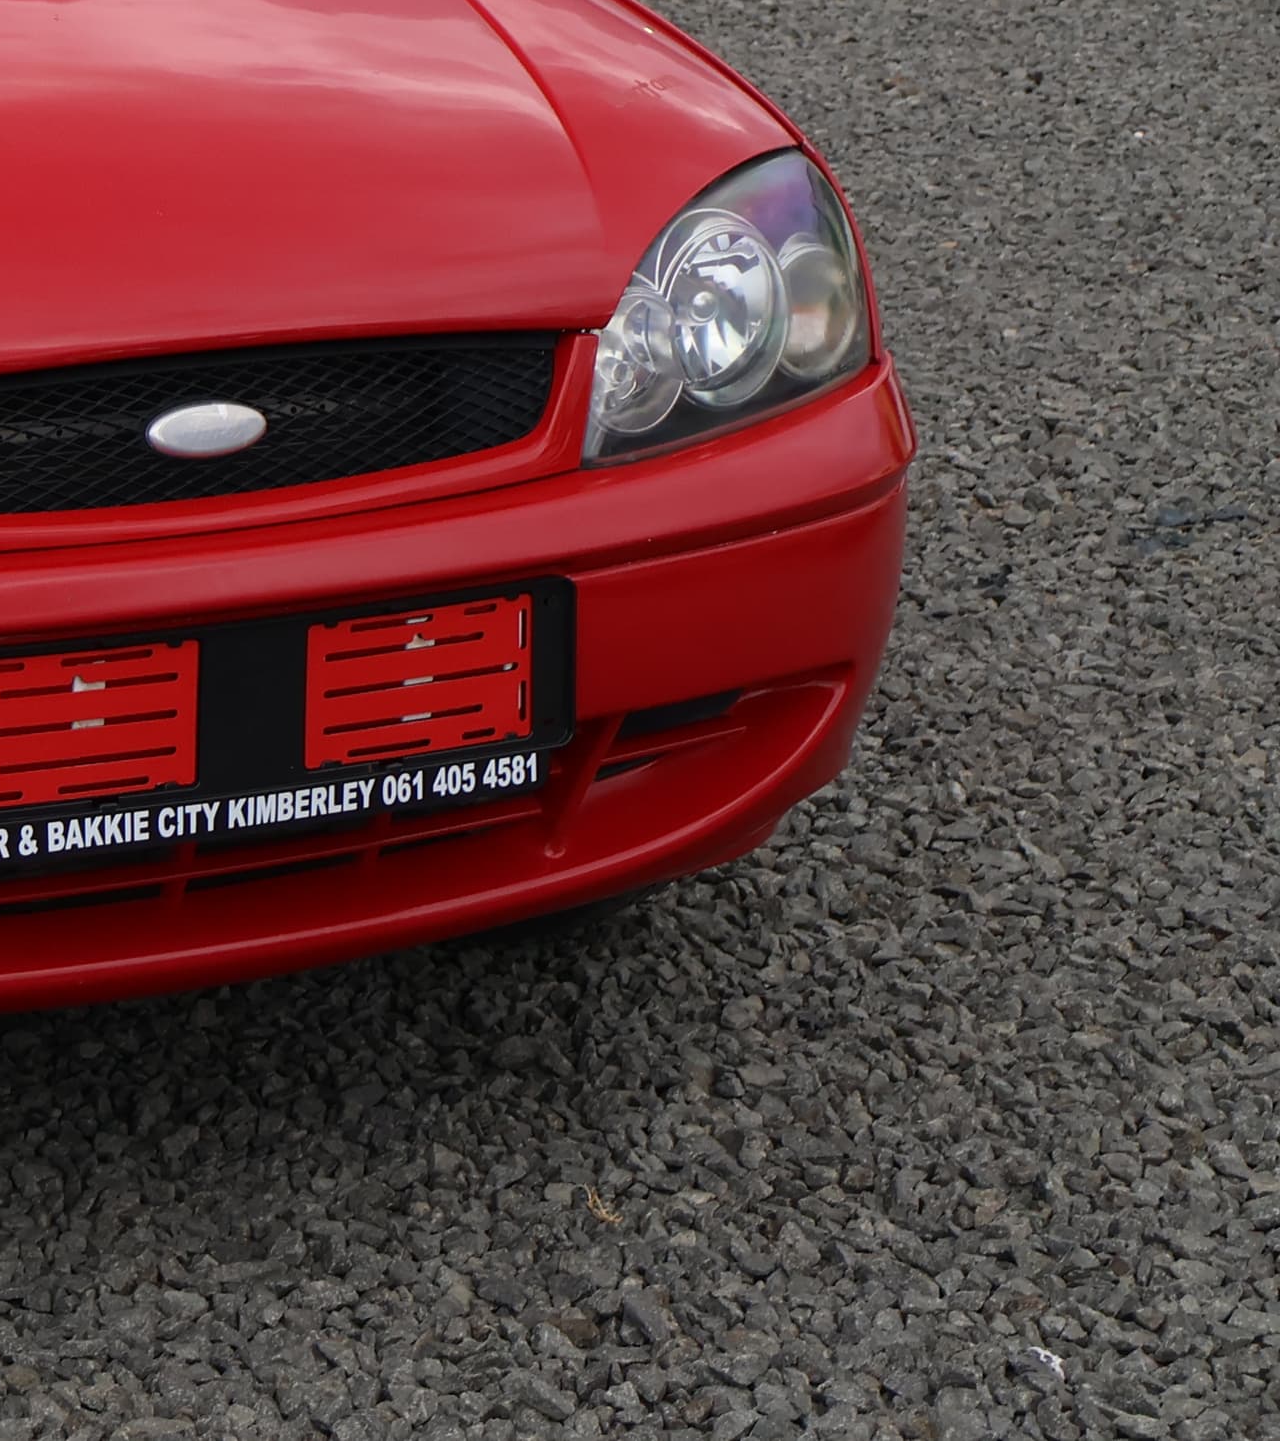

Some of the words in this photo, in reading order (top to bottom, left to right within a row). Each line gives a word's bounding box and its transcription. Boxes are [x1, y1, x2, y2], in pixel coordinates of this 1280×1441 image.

[18, 824, 38, 856] &
[47, 810, 150, 853] BAKKIE
[157, 801, 221, 839] CITY
[228, 778, 376, 830] KIMBERLEY
[382, 770, 425, 806] 061
[433, 762, 477, 797] 405
[483, 752, 538, 789] 4581
